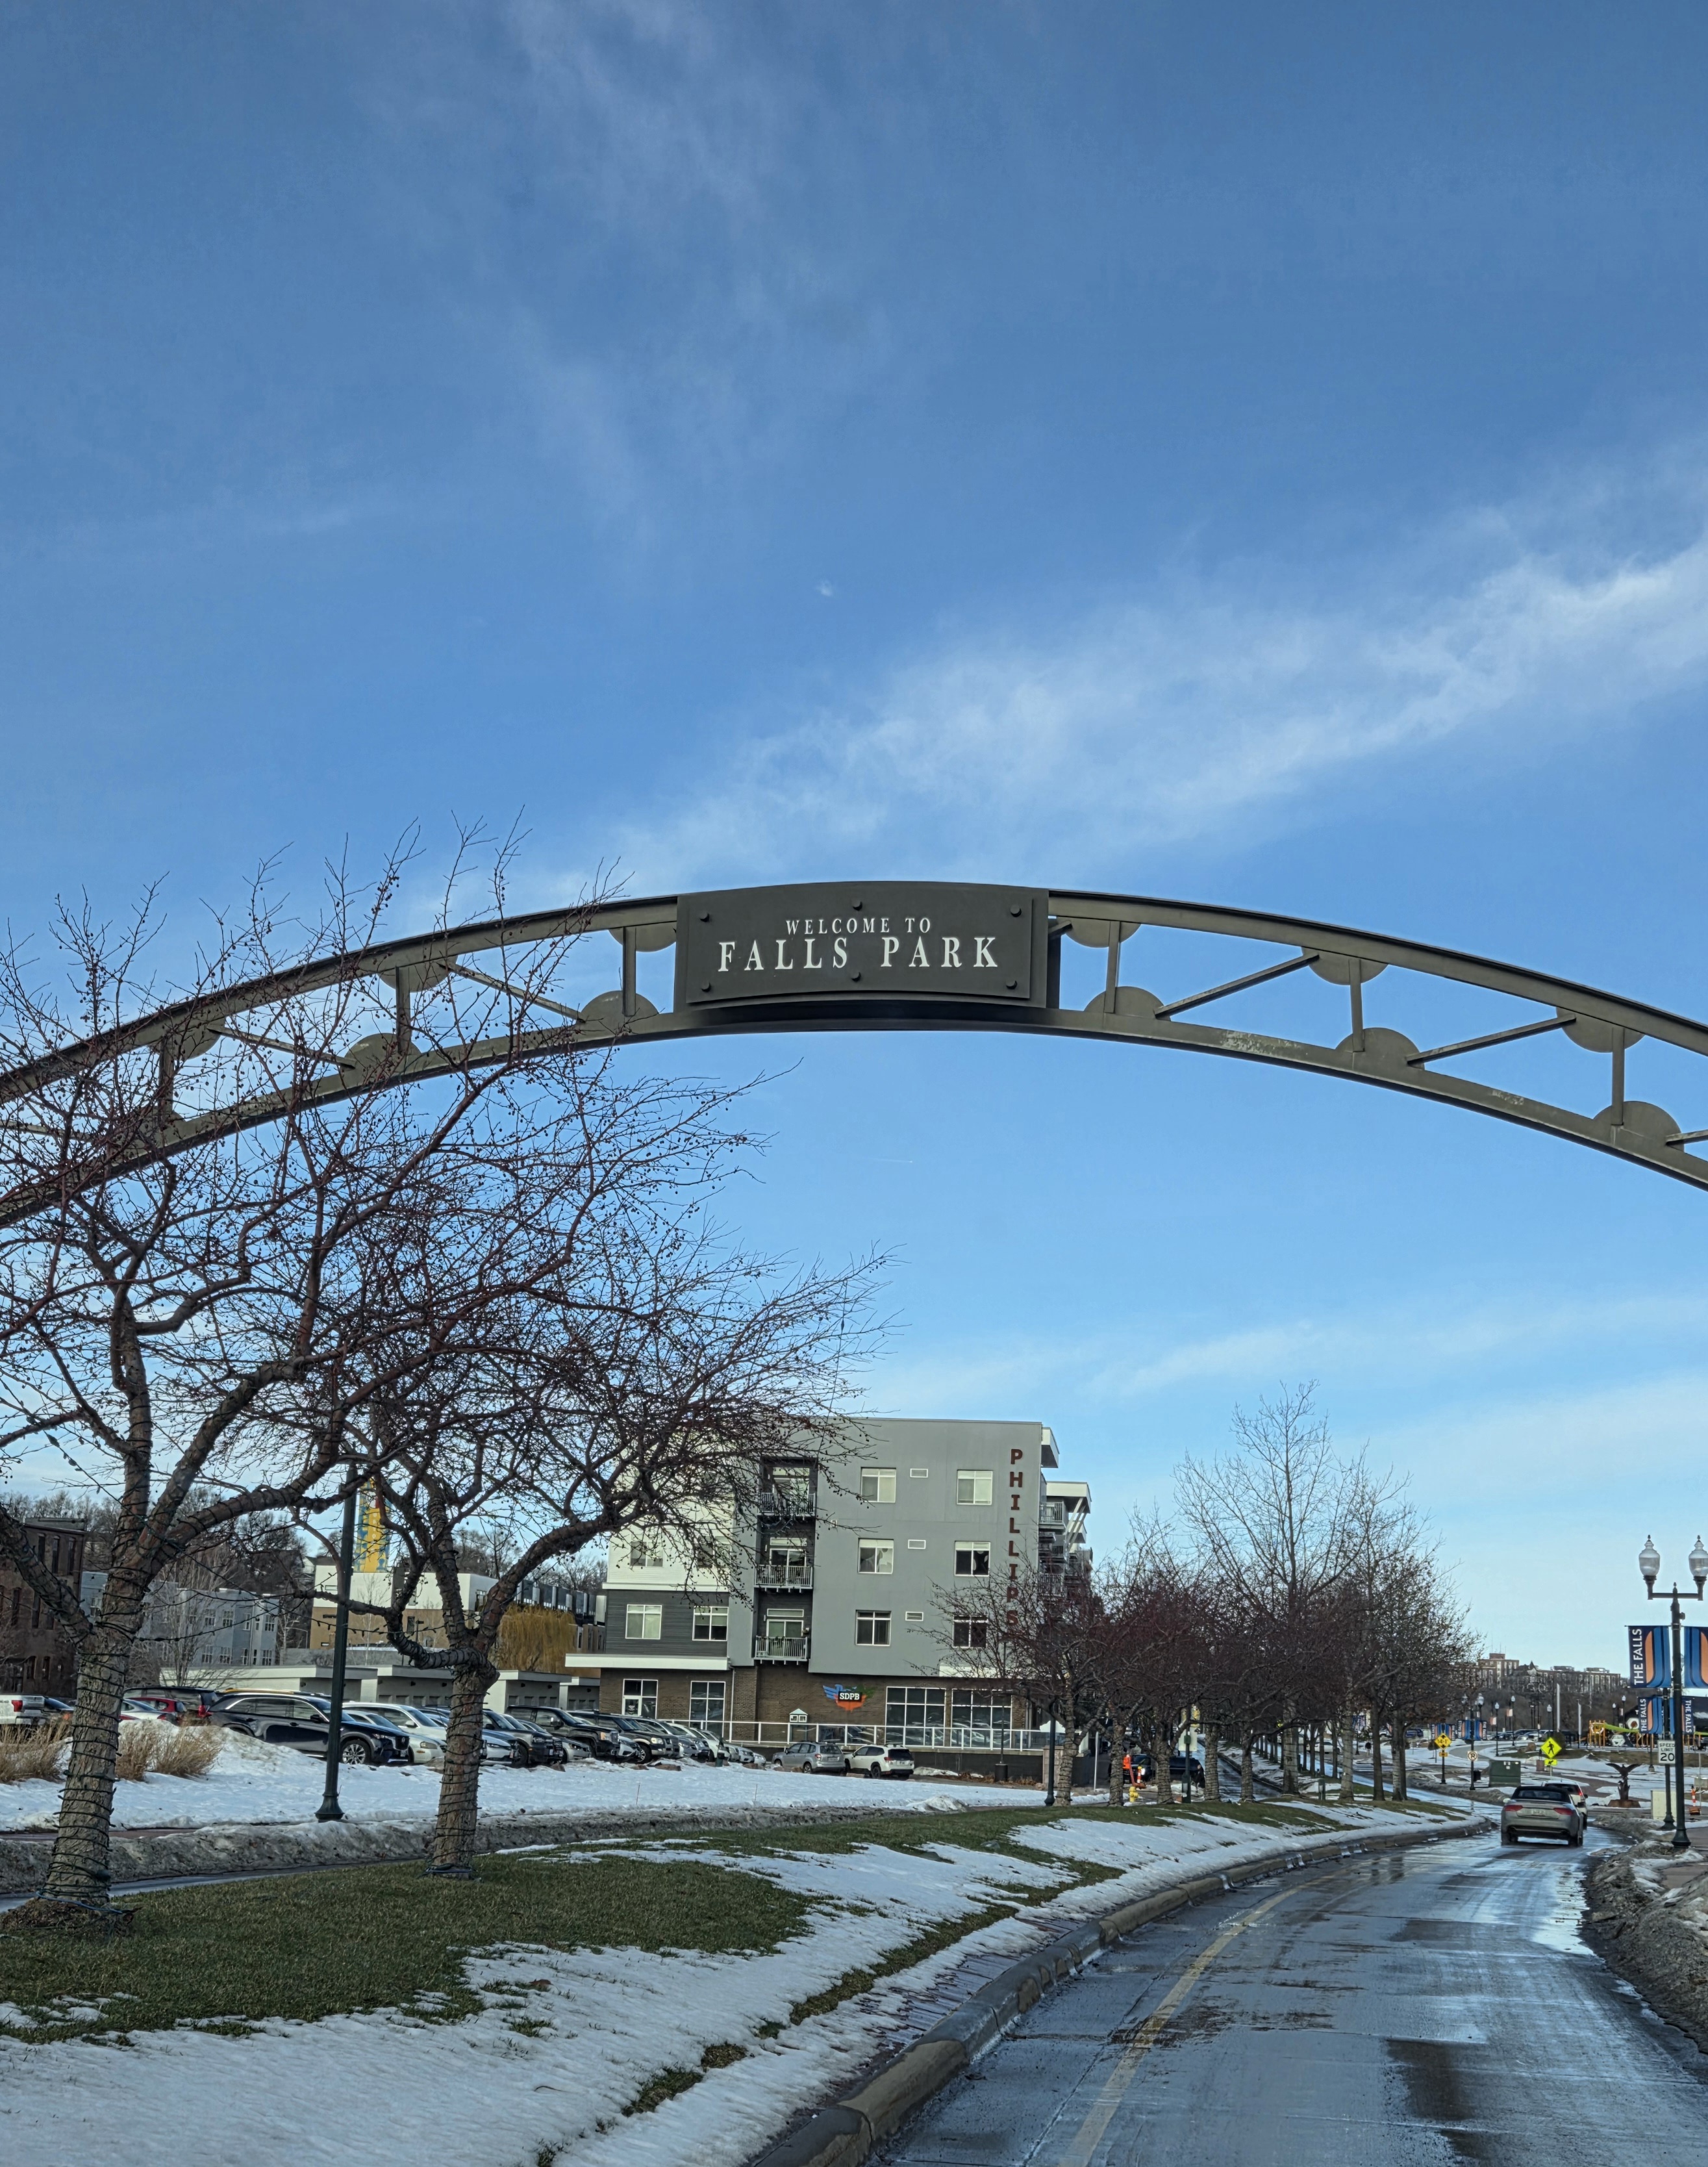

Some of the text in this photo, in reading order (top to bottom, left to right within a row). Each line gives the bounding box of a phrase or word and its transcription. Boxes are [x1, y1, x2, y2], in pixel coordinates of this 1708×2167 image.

[786, 917, 931, 935] WELCOME TO
[718, 936, 998, 972] FALLS PARK
[1006, 1449, 1024, 1626] PHILLIPS
[1632, 1628, 1644, 1686] THE FALLS
[1661, 1753, 1675, 1762] 20
